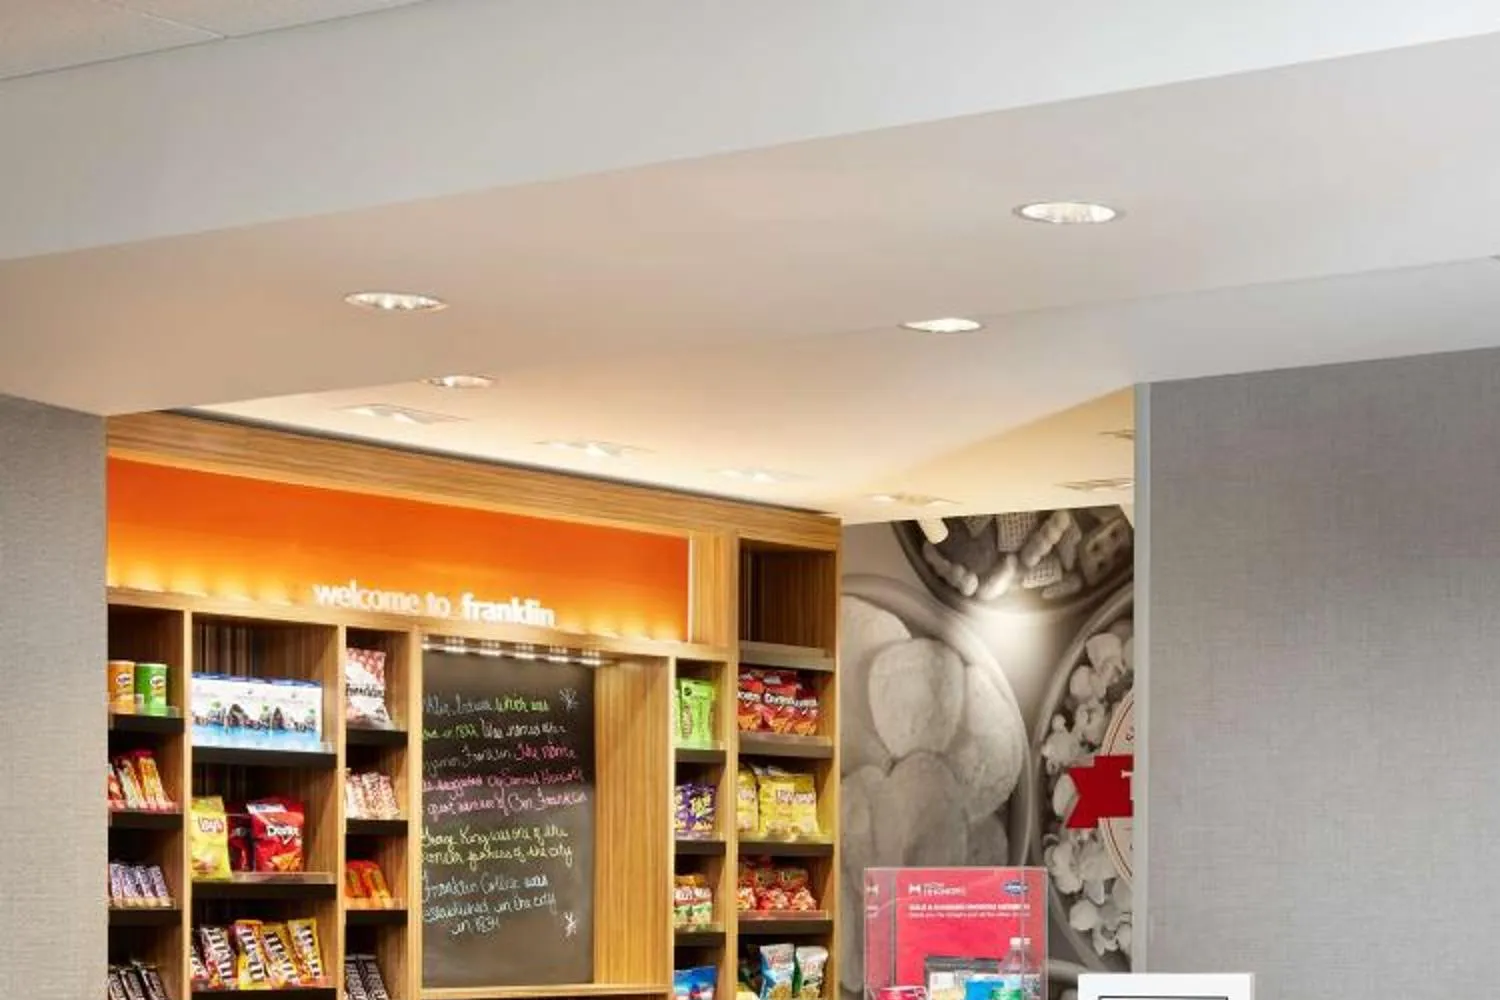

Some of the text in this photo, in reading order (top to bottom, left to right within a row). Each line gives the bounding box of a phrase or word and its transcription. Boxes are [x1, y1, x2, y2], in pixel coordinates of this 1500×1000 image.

[313, 579, 556, 628] welcome to franklin
